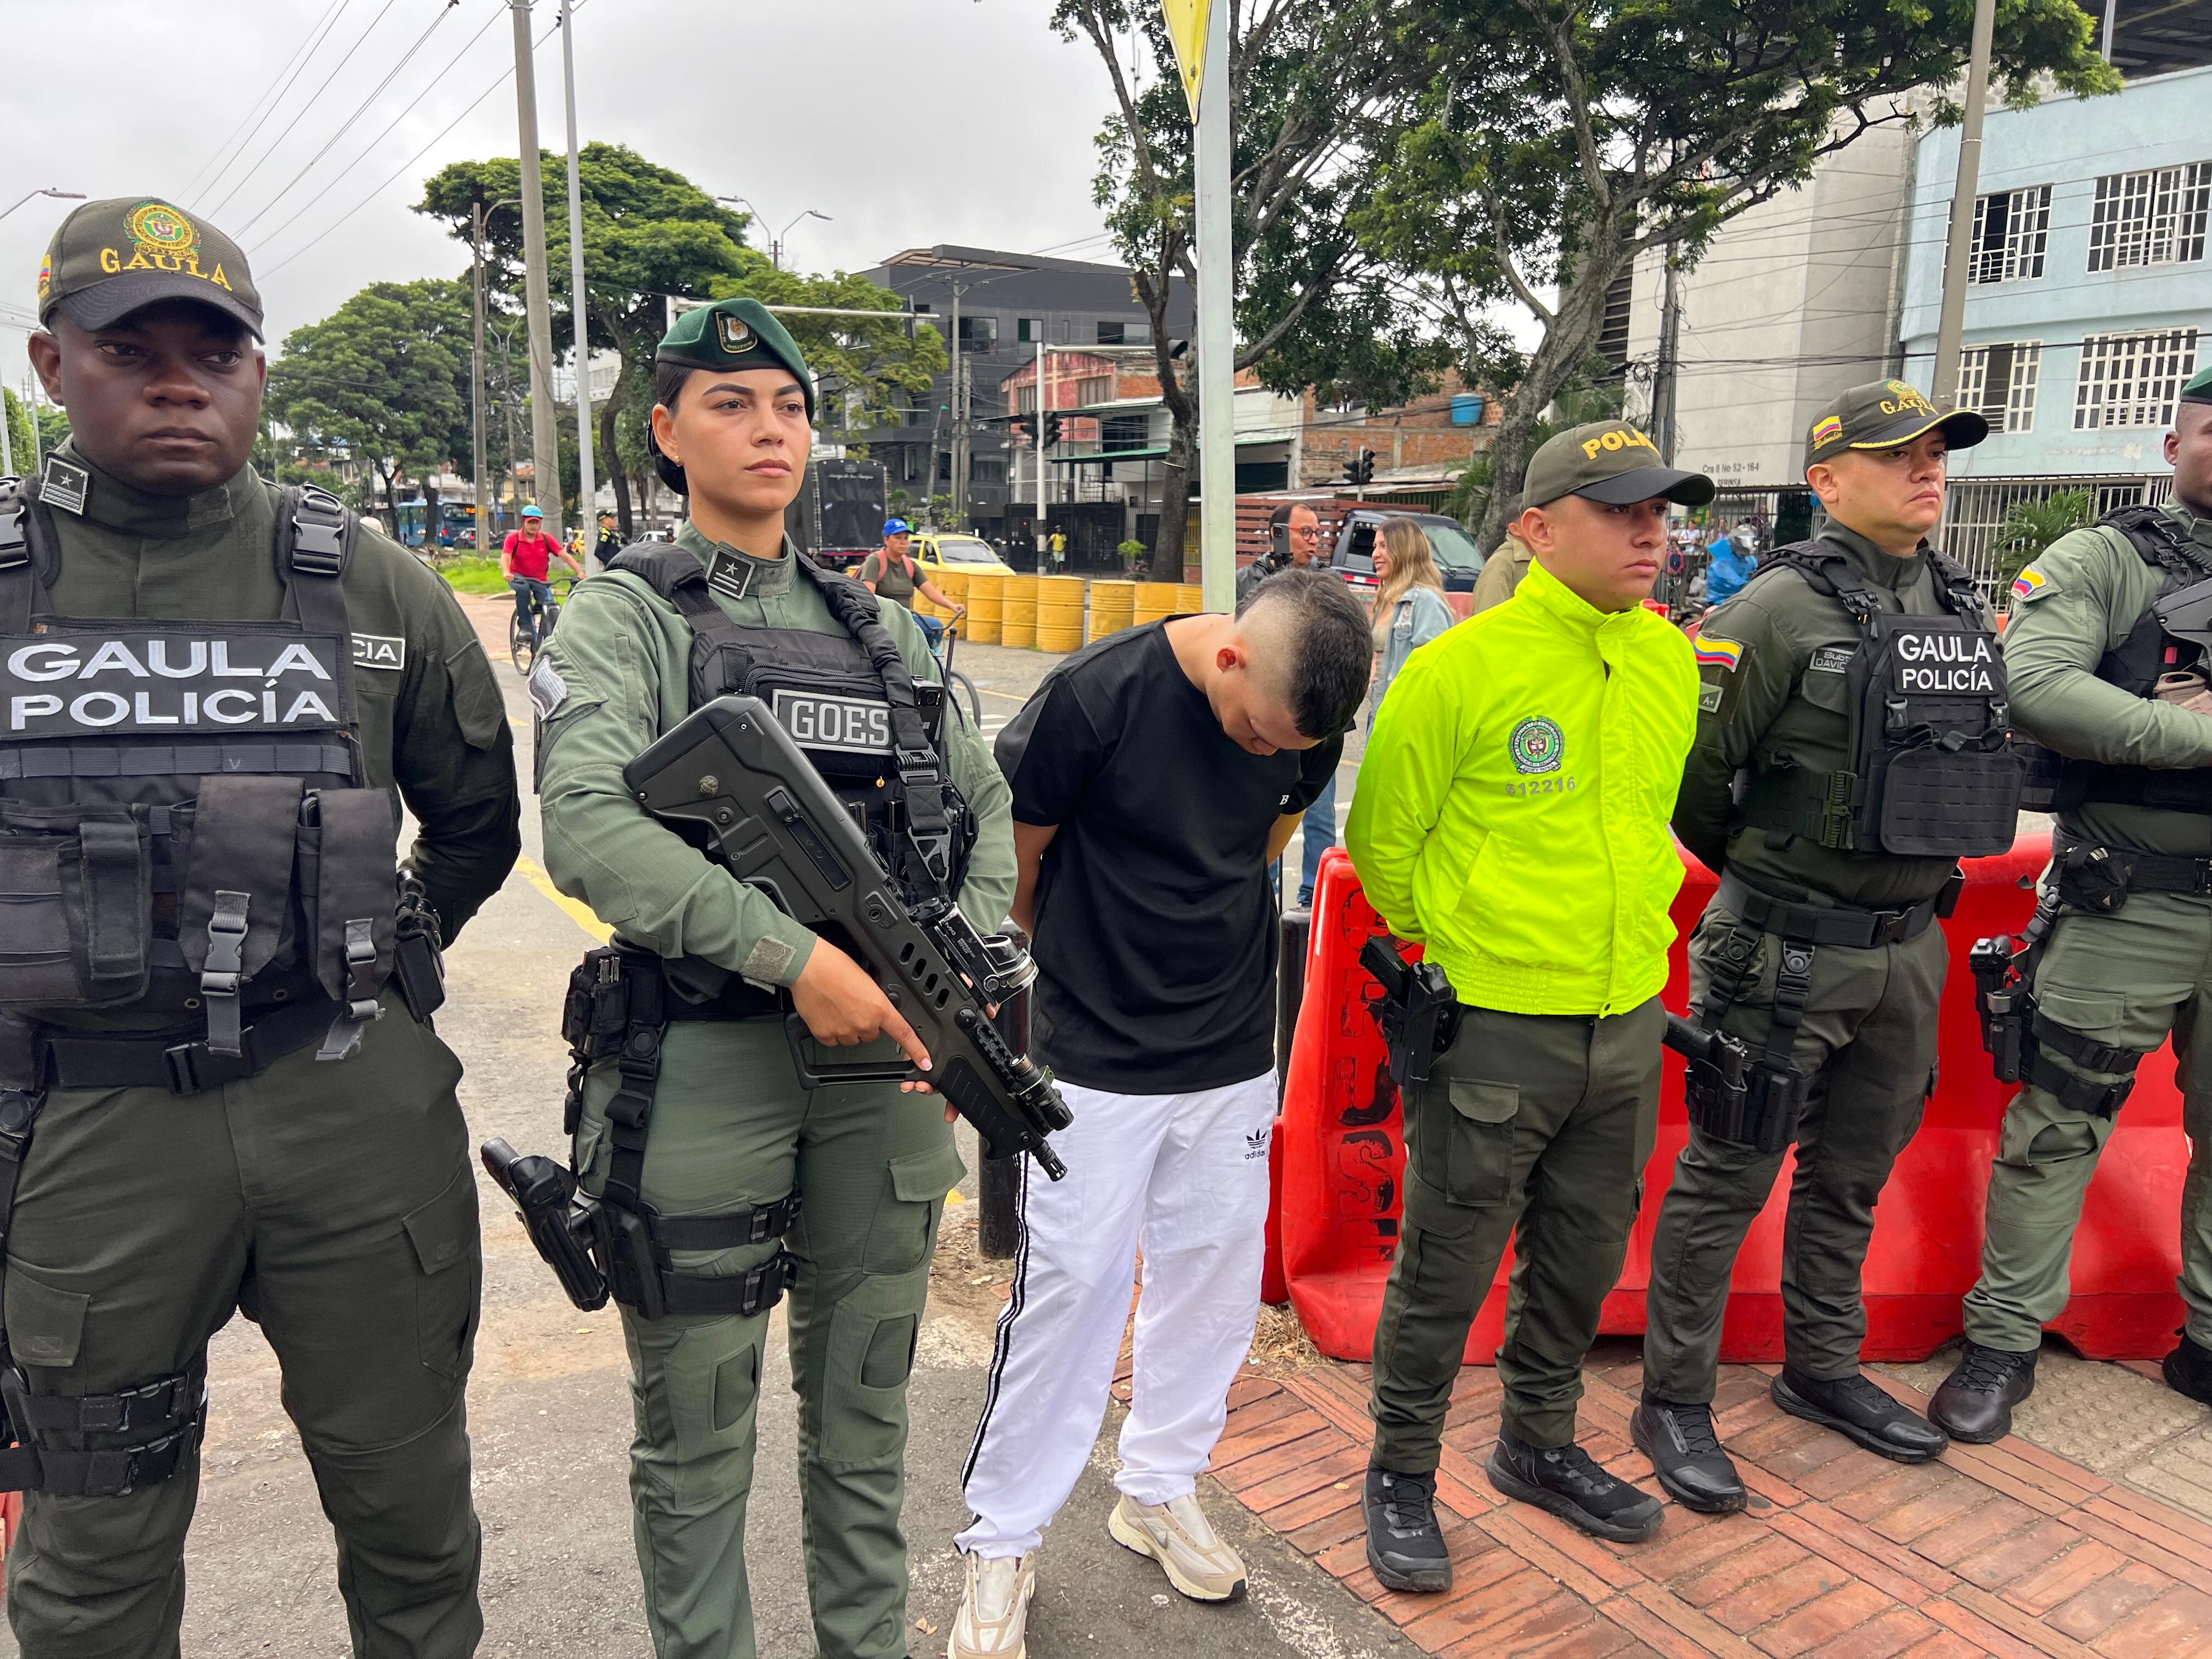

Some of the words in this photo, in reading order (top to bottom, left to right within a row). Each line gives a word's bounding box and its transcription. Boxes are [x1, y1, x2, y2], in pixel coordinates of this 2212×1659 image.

[100, 248, 233, 291] GAULA
[1722, 464, 1731, 472] No
[1747, 462, 1759, 472] 164
[7, 640, 332, 682] GAULA
[1898, 634, 1993, 663] GAULA
[1902, 664, 1994, 691] POLICÍA
[10, 678, 339, 730] POLICÍA
[791, 701, 889, 746] GOES
[1244, 1149, 1265, 1160] adidas
